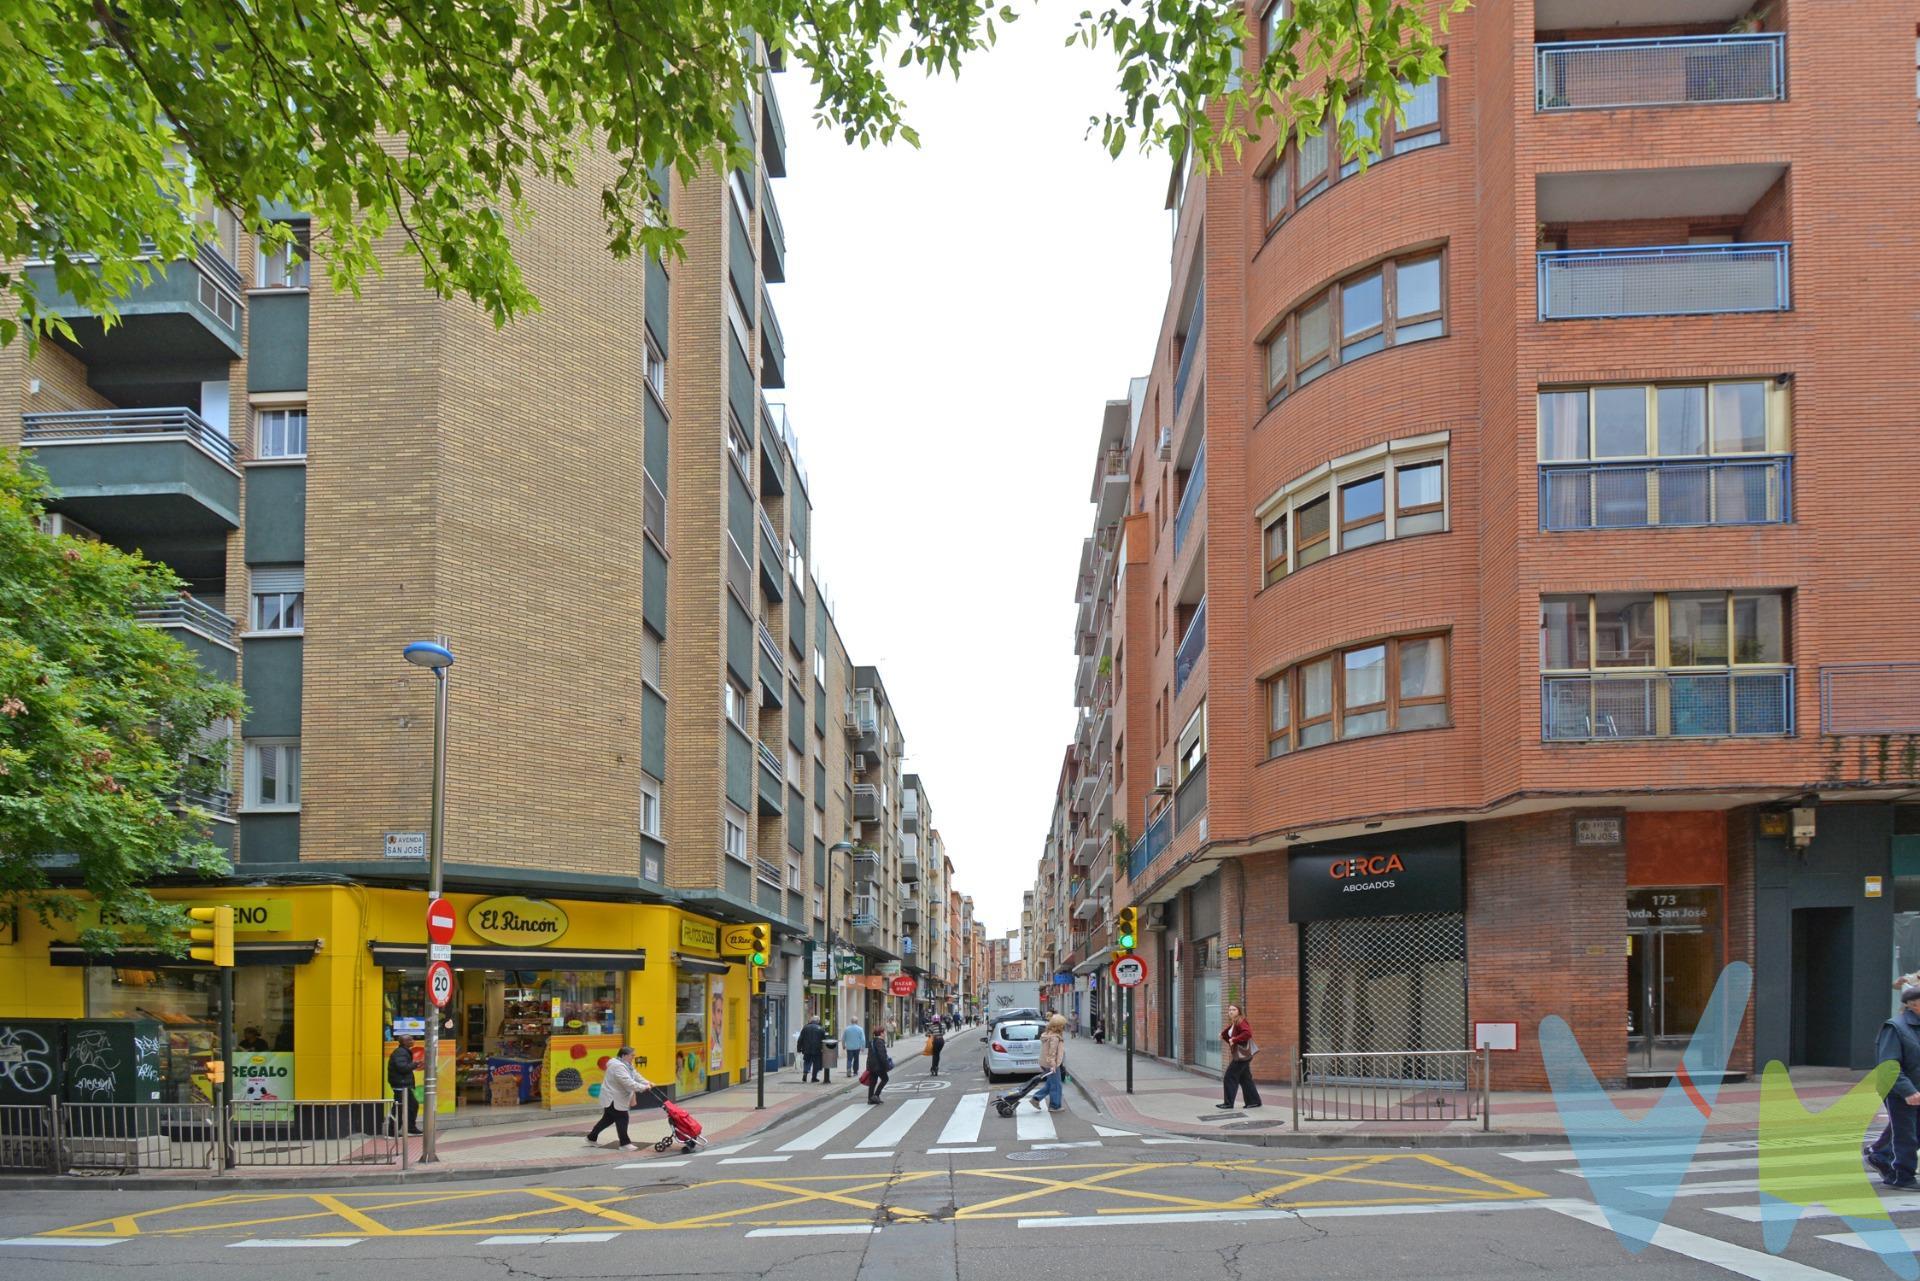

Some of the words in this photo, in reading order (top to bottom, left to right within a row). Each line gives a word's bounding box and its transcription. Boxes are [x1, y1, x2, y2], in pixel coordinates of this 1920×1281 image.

[387, 846, 402, 854] SAN
[1329, 854, 1405, 879] CERCA
[1343, 880, 1396, 893] ABOGADOS
[1652, 895, 1677, 906] 173
[1657, 909, 1679, 918] San
[1682, 907, 1708, 918] José
[479, 910, 499, 930] El
[500, 911, 558, 932] Rincón
[434, 976, 448, 991] 20
[232, 1065, 288, 1078] REGALO
